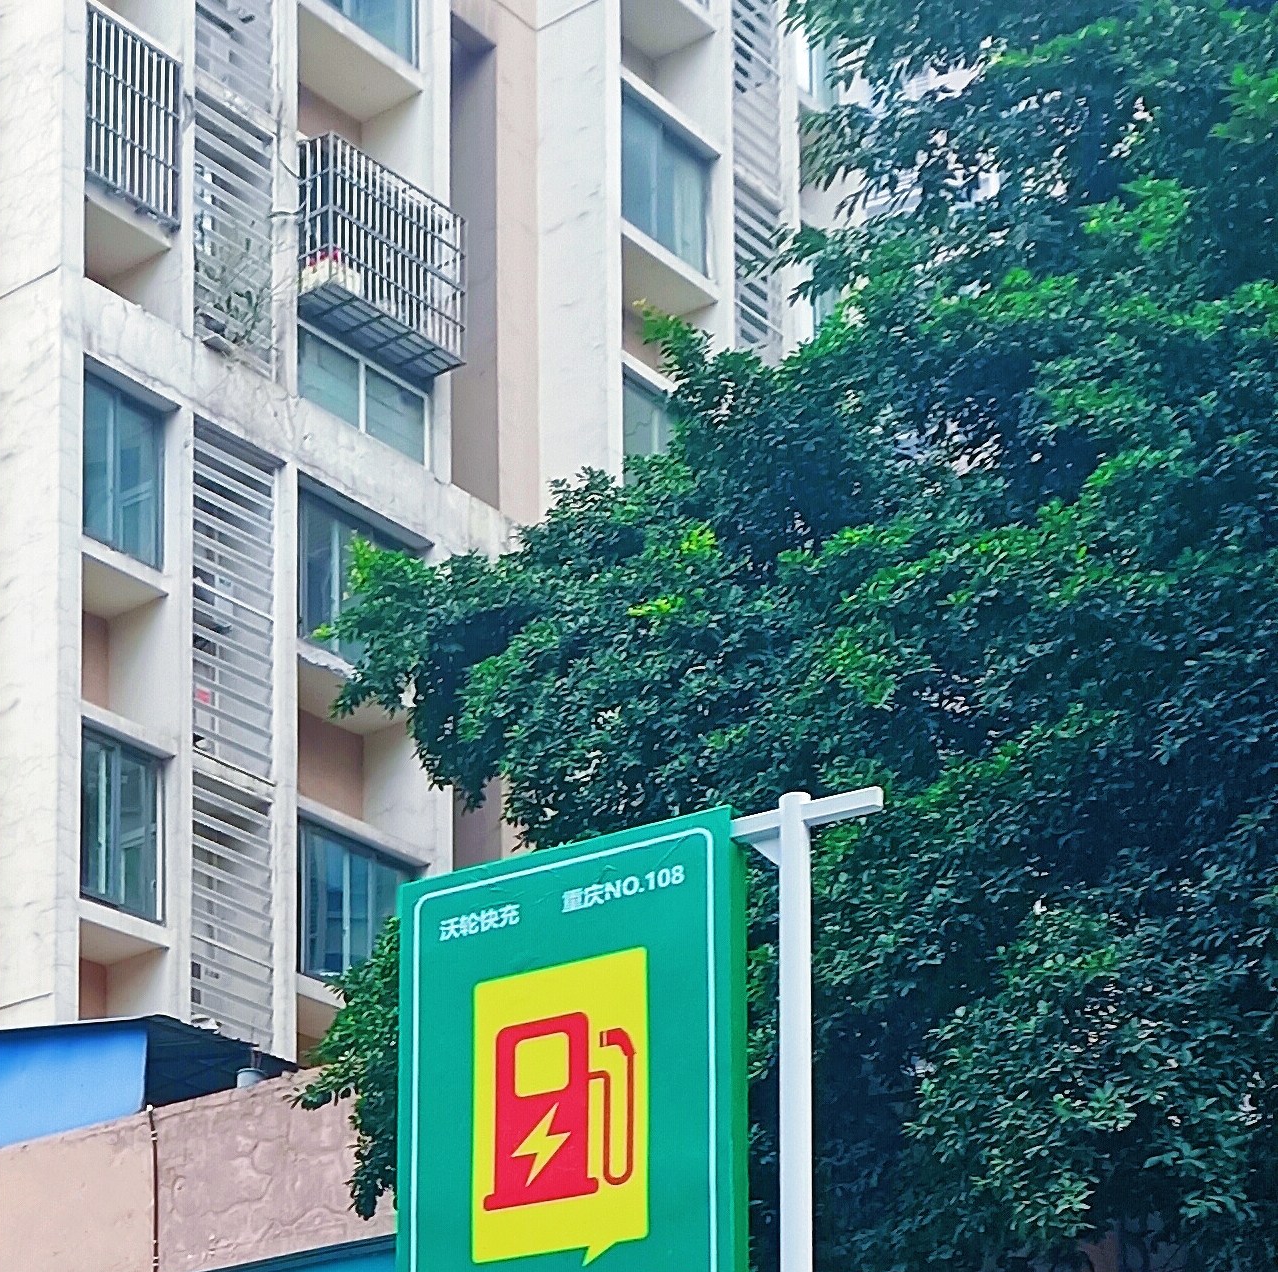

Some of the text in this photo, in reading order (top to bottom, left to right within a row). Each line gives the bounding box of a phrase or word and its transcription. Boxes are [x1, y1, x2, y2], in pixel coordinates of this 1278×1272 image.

[438, 865, 685, 941] 沃轮快充 重庆NO.108
